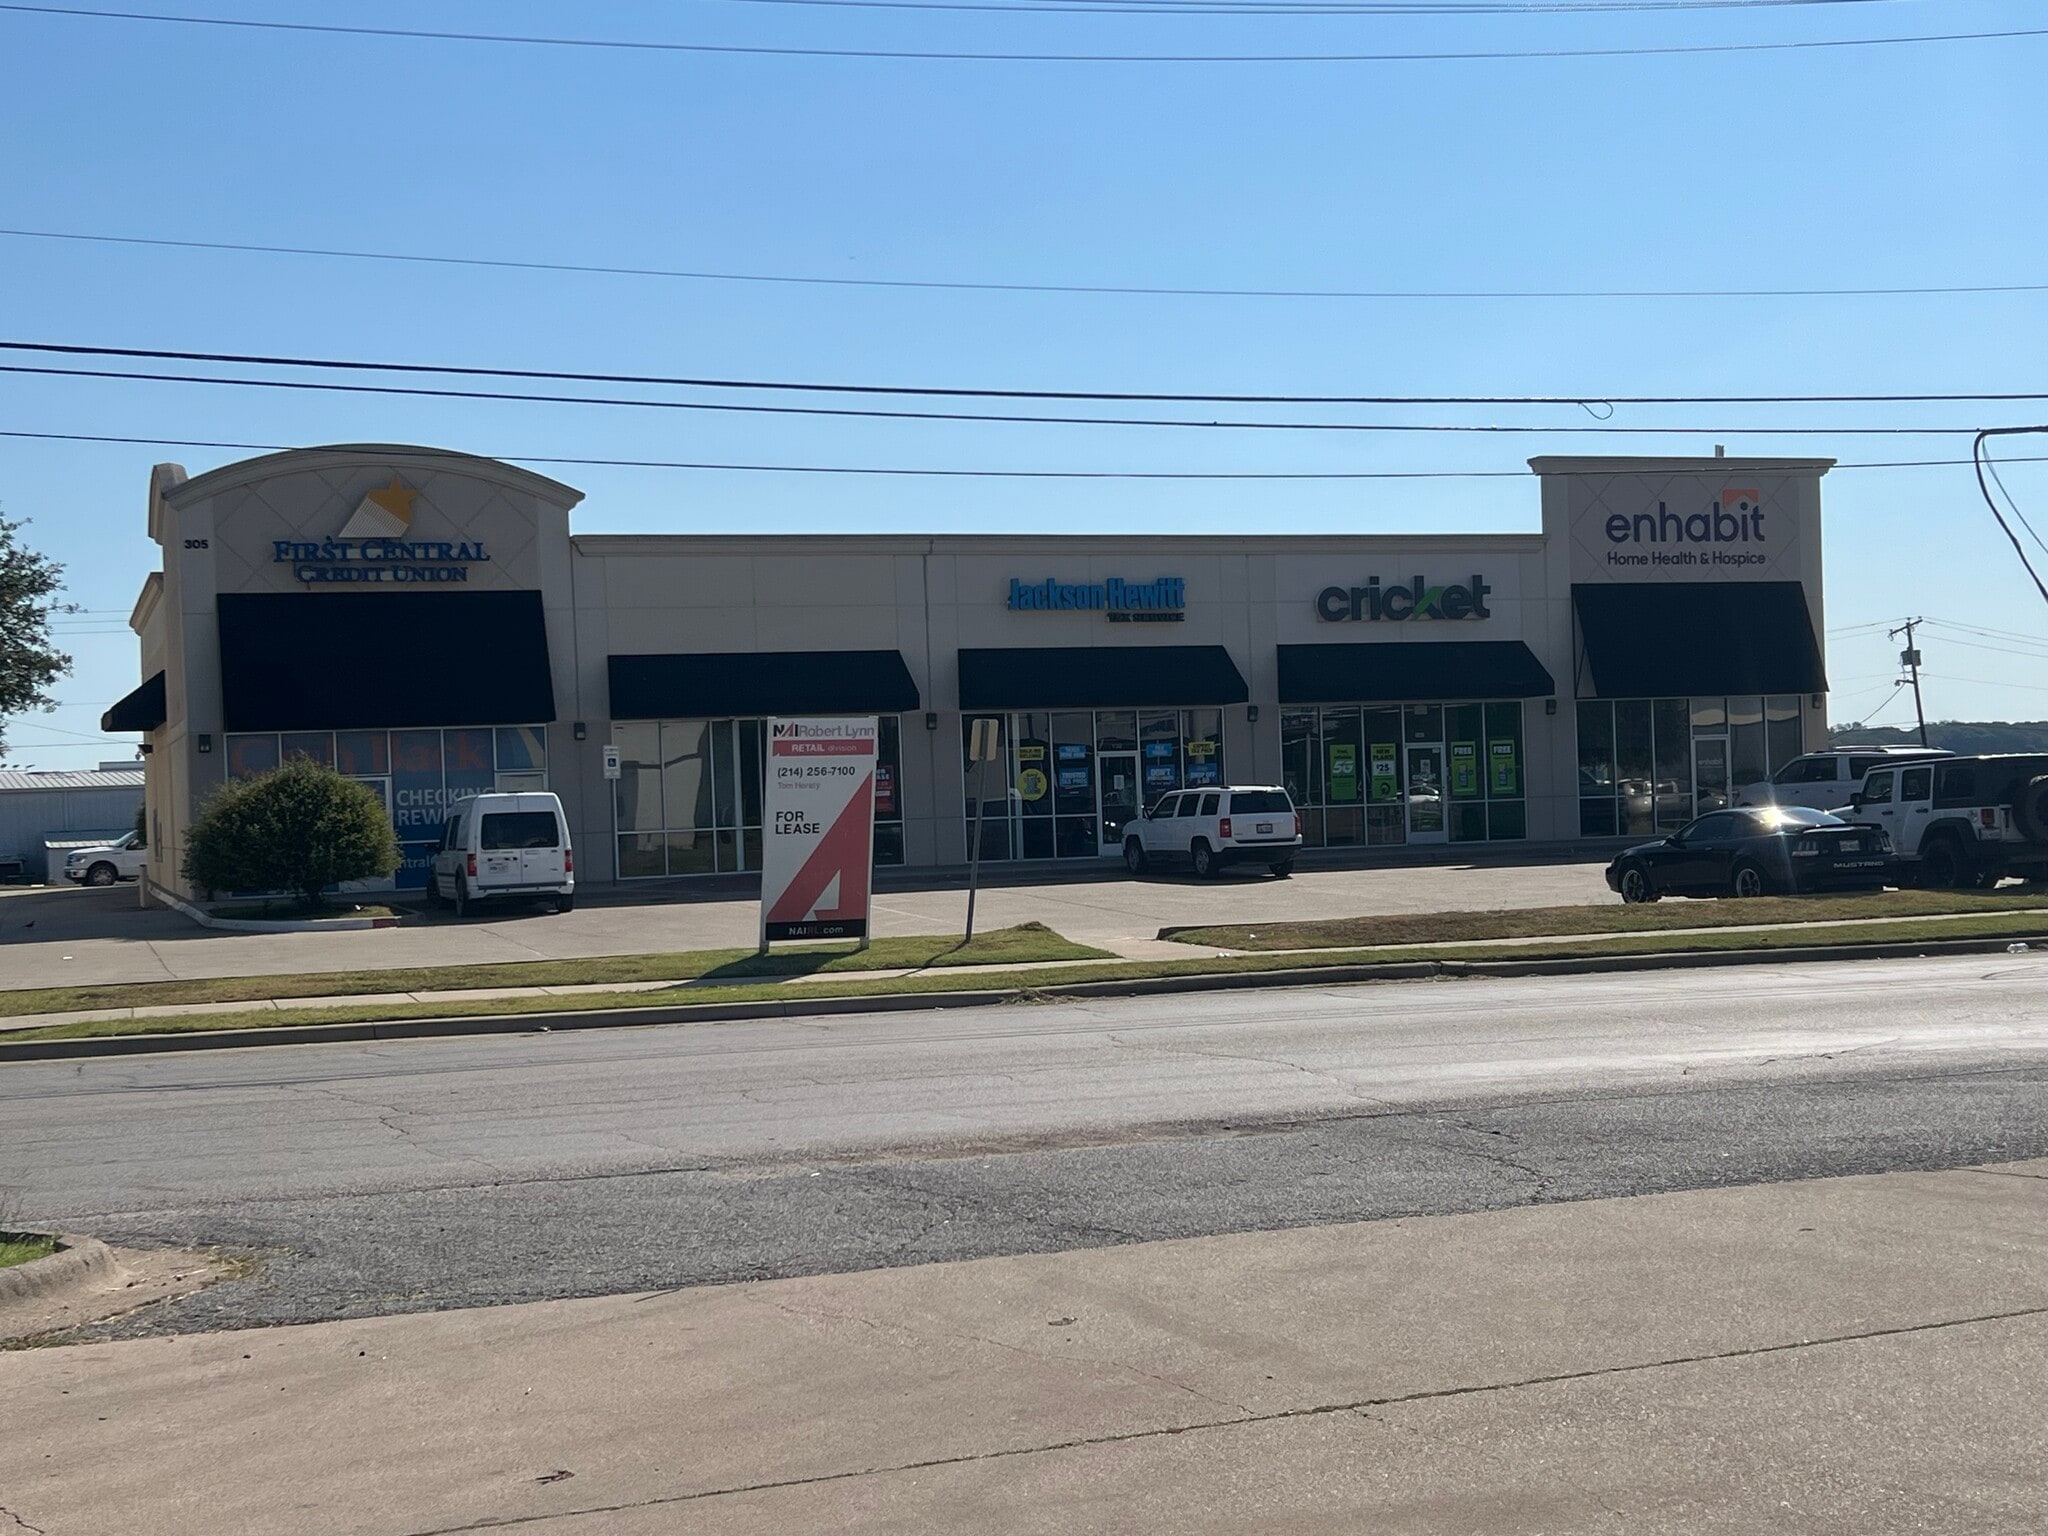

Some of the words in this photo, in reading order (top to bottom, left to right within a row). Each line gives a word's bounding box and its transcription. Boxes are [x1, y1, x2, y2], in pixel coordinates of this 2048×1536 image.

[1606, 502, 1765, 542] enhabit
[184, 539, 209, 549] 305
[273, 540, 354, 562] FIRST
[361, 540, 491, 562] CENTRAL
[1607, 552, 1648, 565] Home
[1652, 551, 1697, 565] Health
[1700, 552, 1709, 565] &
[1713, 551, 1766, 567] Hospice
[297, 565, 383, 582] CREDIT
[393, 565, 468, 582] UNION
[1008, 578, 1105, 610] Jackson
[1107, 577, 1185, 610] Hewitt
[1317, 575, 1491, 622] cricket
[773, 723, 799, 737] NAI
[799, 724, 842, 737] Robert
[845, 724, 875, 738] Lynn
[791, 743, 825, 752] RETAIL
[827, 743, 857, 752] division
[777, 767, 803, 778] (214)
[807, 766, 856, 776] 256-7100
[1332, 759, 1354, 774] 5G
[776, 811, 804, 822] FOR
[775, 823, 820, 834] LEASE
